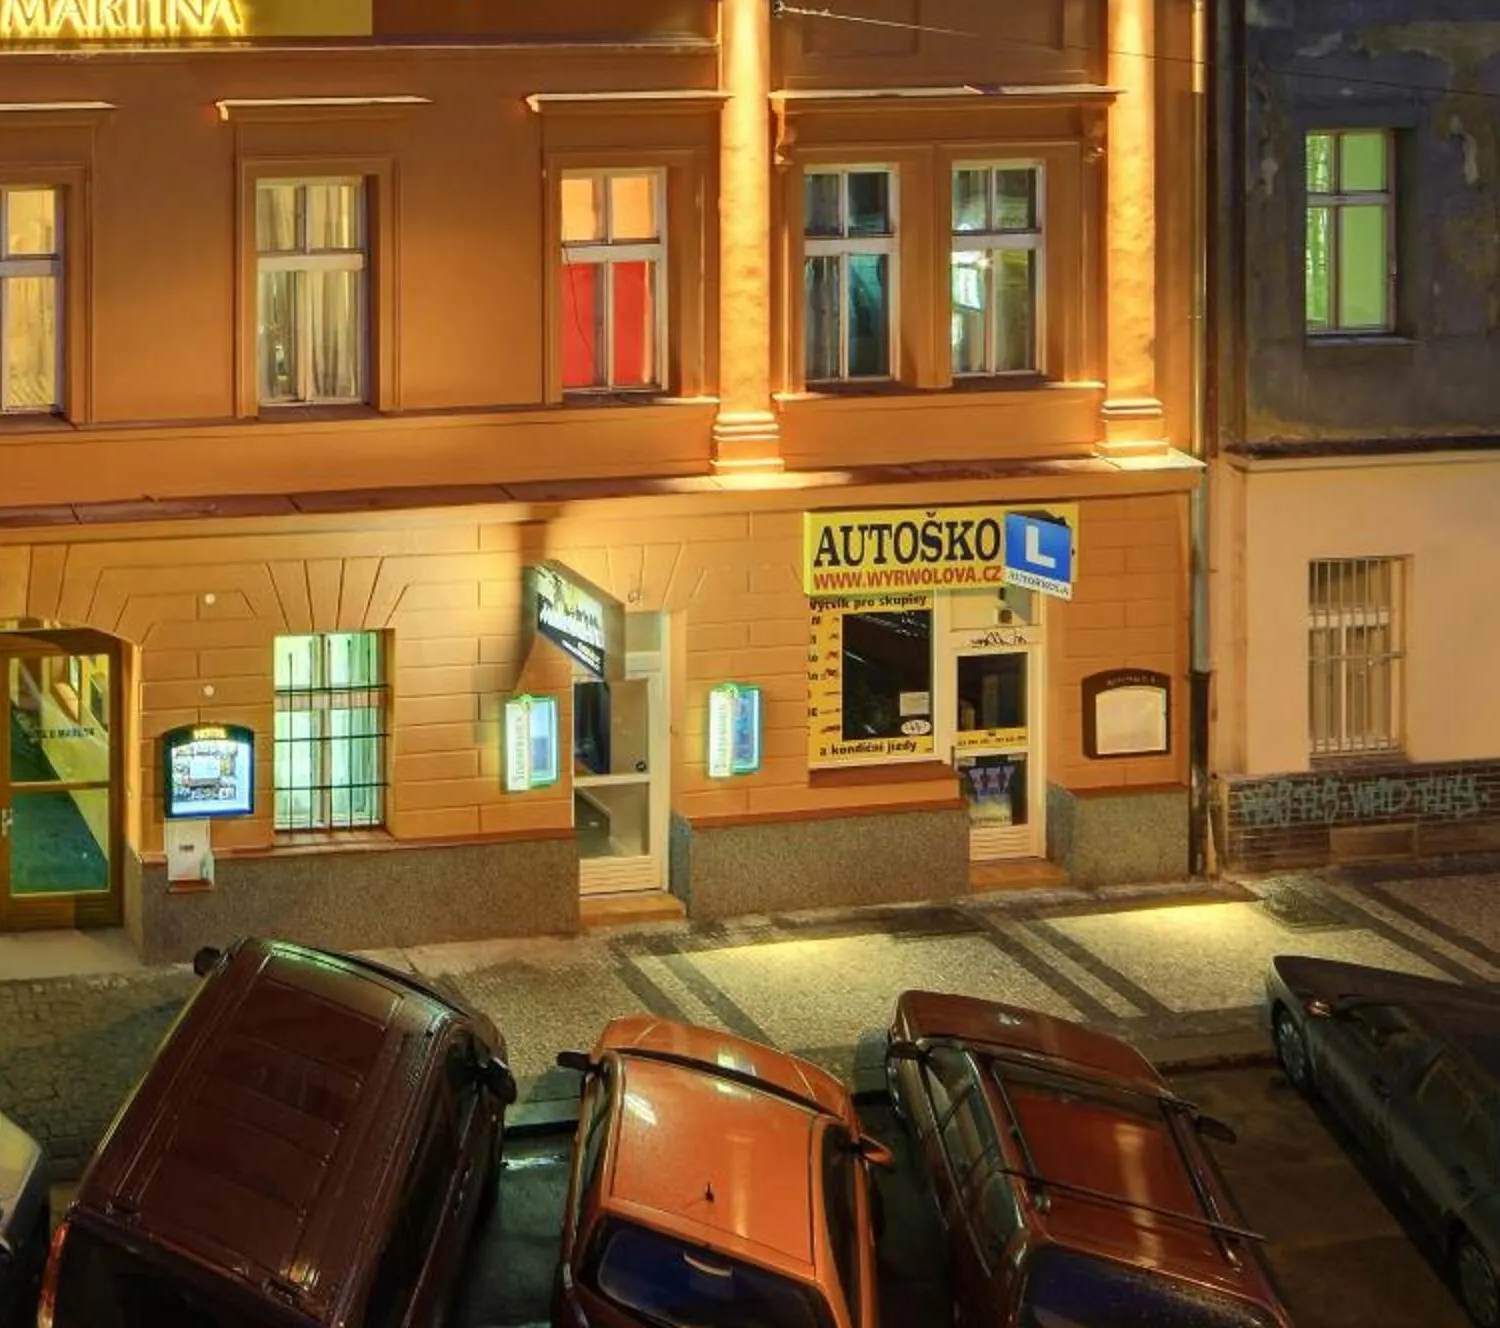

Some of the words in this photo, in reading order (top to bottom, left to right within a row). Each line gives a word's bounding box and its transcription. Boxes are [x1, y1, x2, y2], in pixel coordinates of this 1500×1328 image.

[813, 511, 1001, 567] AUTOŠKO
[1025, 524, 1056, 569] L
[813, 565, 1002, 591] WWW.WYRWOLOVA.CZ
